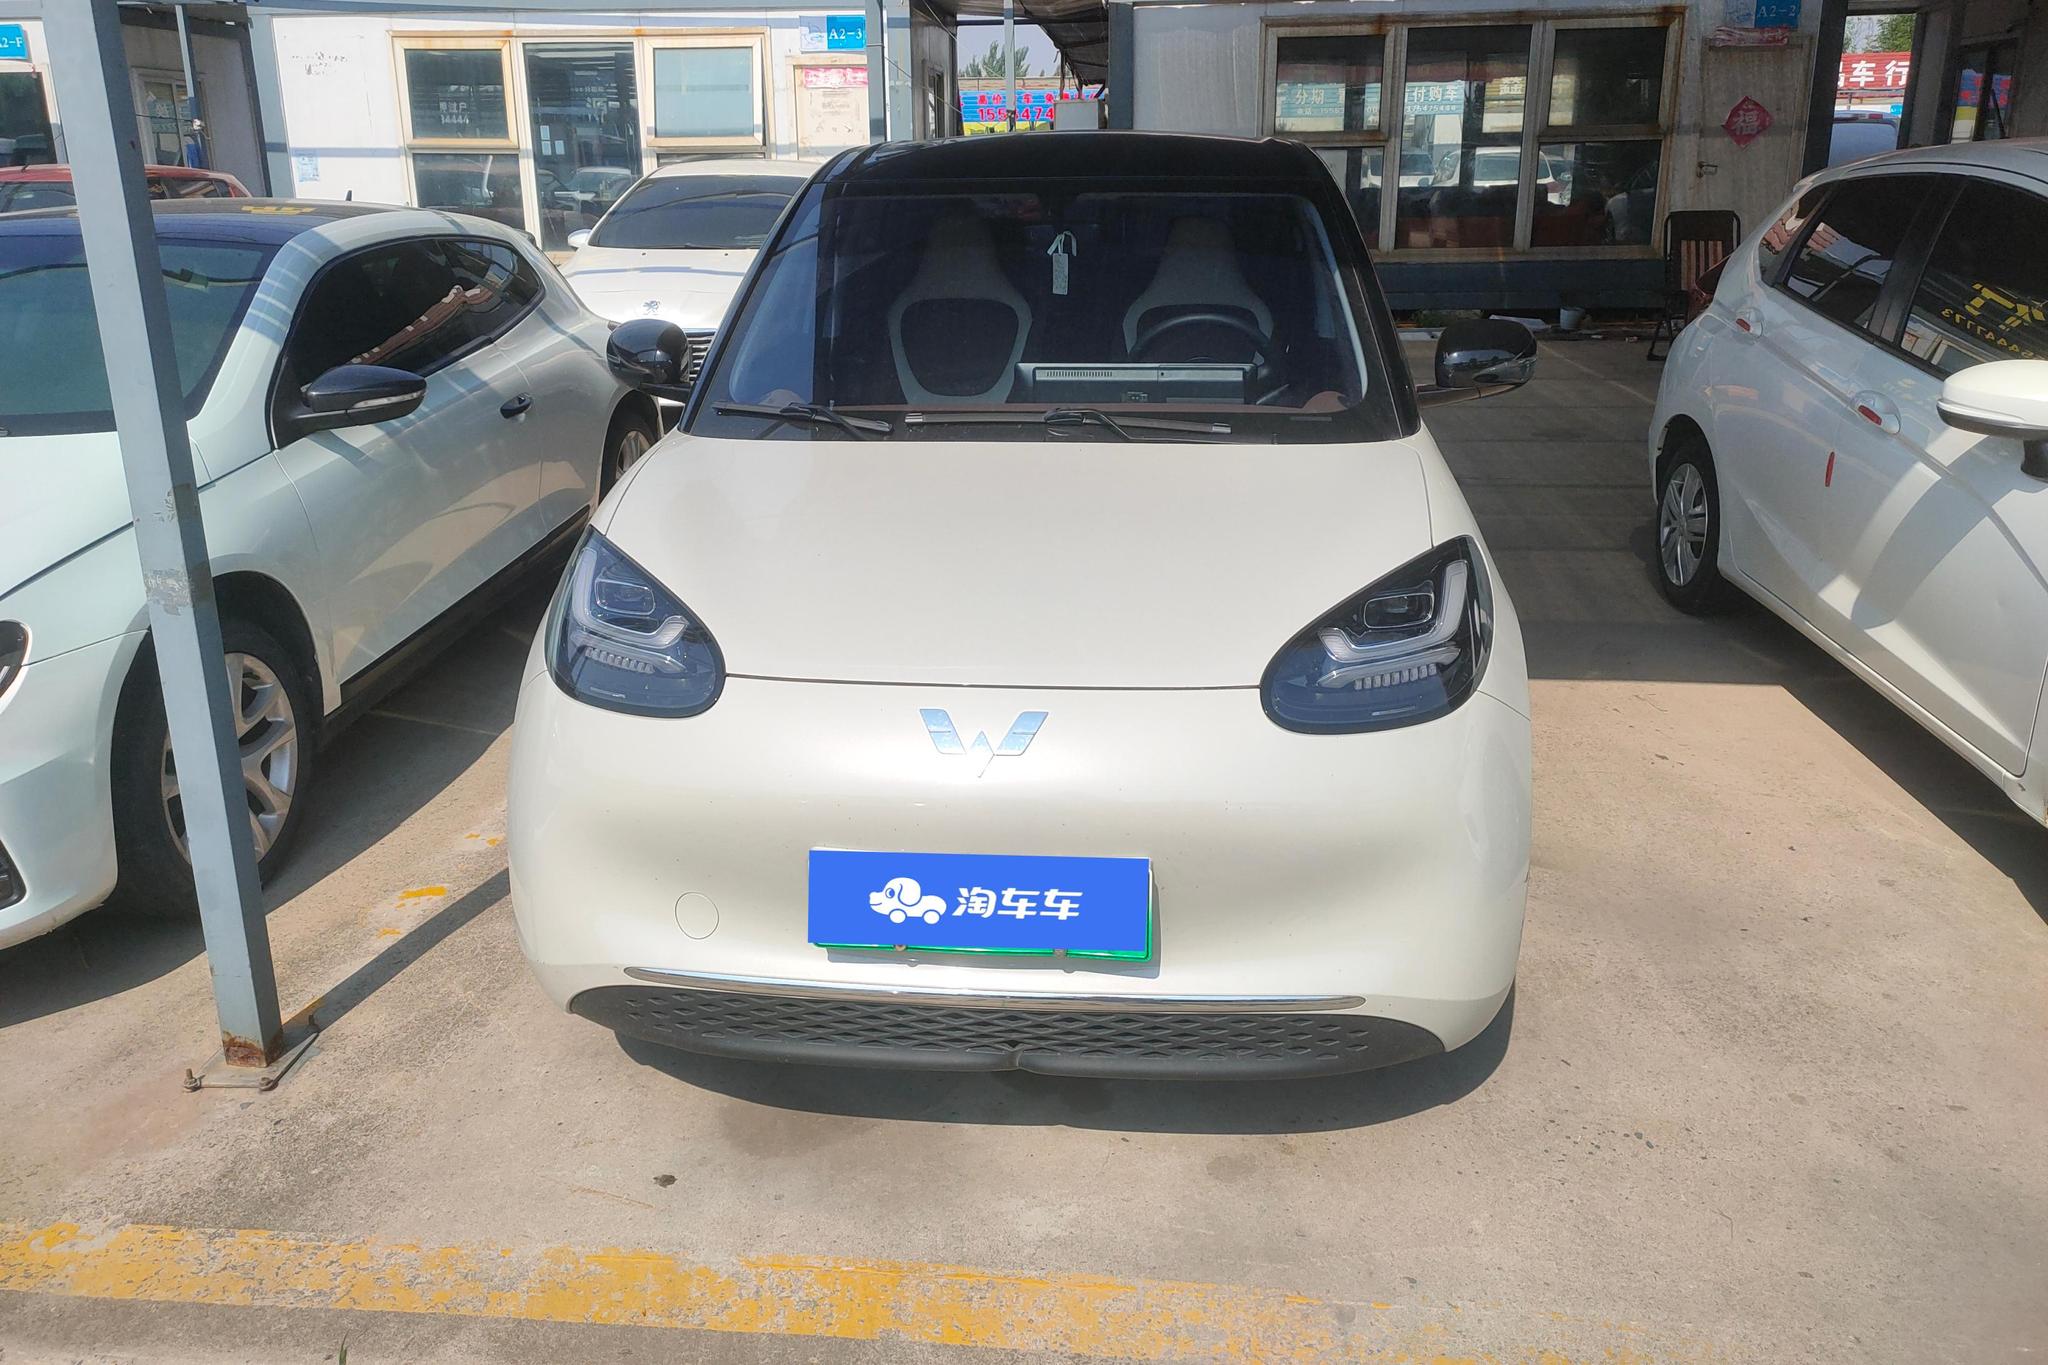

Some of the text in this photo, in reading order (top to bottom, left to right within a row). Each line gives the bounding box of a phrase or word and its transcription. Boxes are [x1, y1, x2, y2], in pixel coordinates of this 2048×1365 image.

[1756, 5, 1797, 18] A2-2
[828, 28, 863, 40] A2-3
[0, 36, 24, 48] 2-F
[1404, 85, 1457, 103] 付购车
[977, 107, 1055, 121] 155474
[1733, 110, 1761, 135] 福
